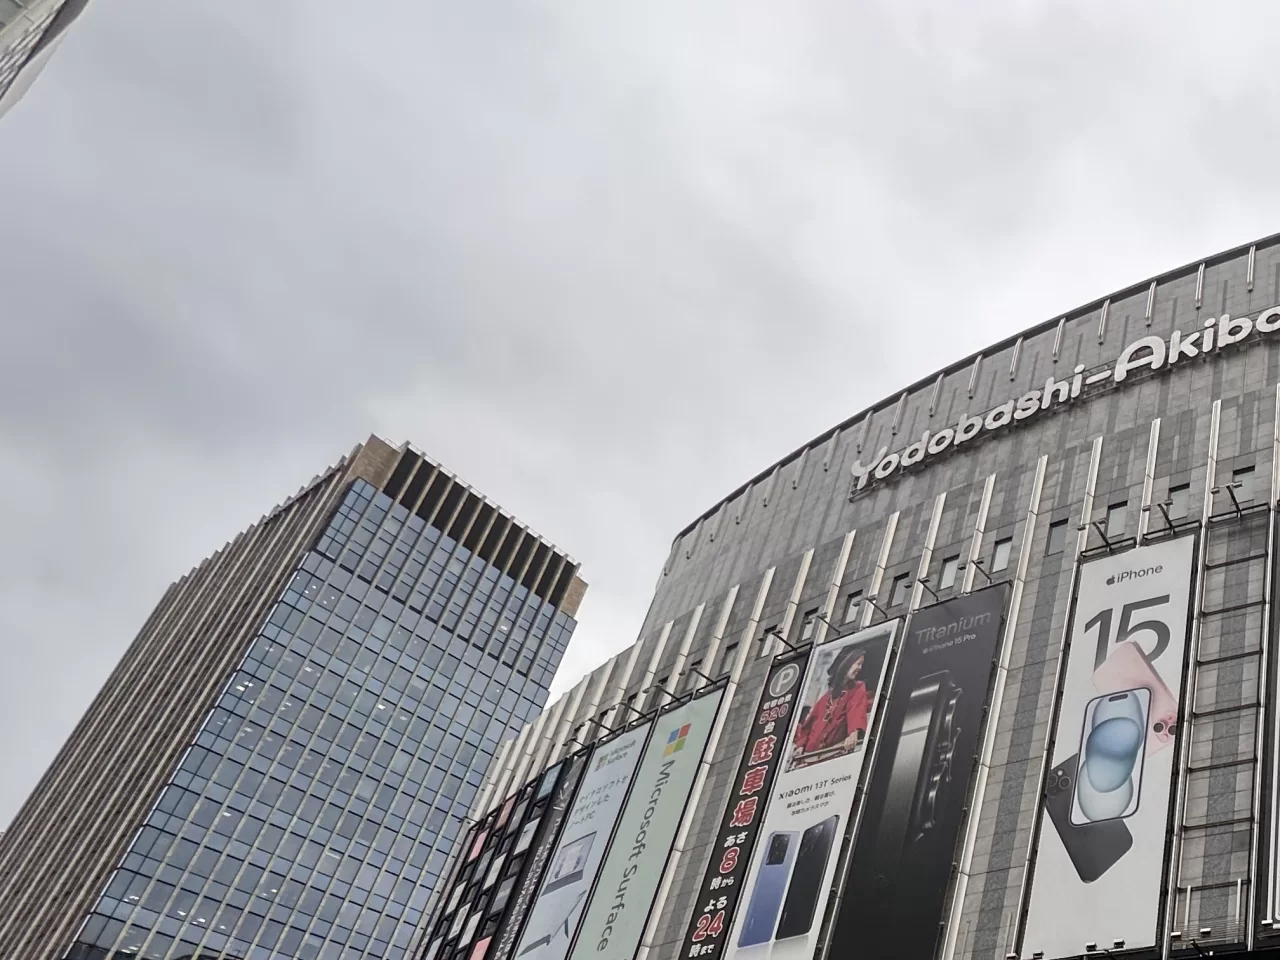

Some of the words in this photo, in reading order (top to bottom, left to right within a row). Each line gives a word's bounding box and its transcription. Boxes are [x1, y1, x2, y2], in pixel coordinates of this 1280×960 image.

[1116, 564, 1163, 584] iPhone
[916, 612, 991, 645] Titanium
[963, 633, 976, 643] Pro
[1083, 594, 1172, 676] 15
[759, 703, 789, 725] 520
[730, 735, 777, 828] 駐車場
[815, 780, 829, 790] 13T
[831, 774, 852, 786] Series
[628, 760, 677, 861] Microsoft
[724, 831, 748, 848] あさ
[719, 846, 740, 874] 8
[710, 876, 735, 890] 時から
[597, 865, 637, 952] Surface
[704, 895, 728, 912] よる
[692, 910, 725, 942] 24
[688, 944, 715, 958] 時まで
